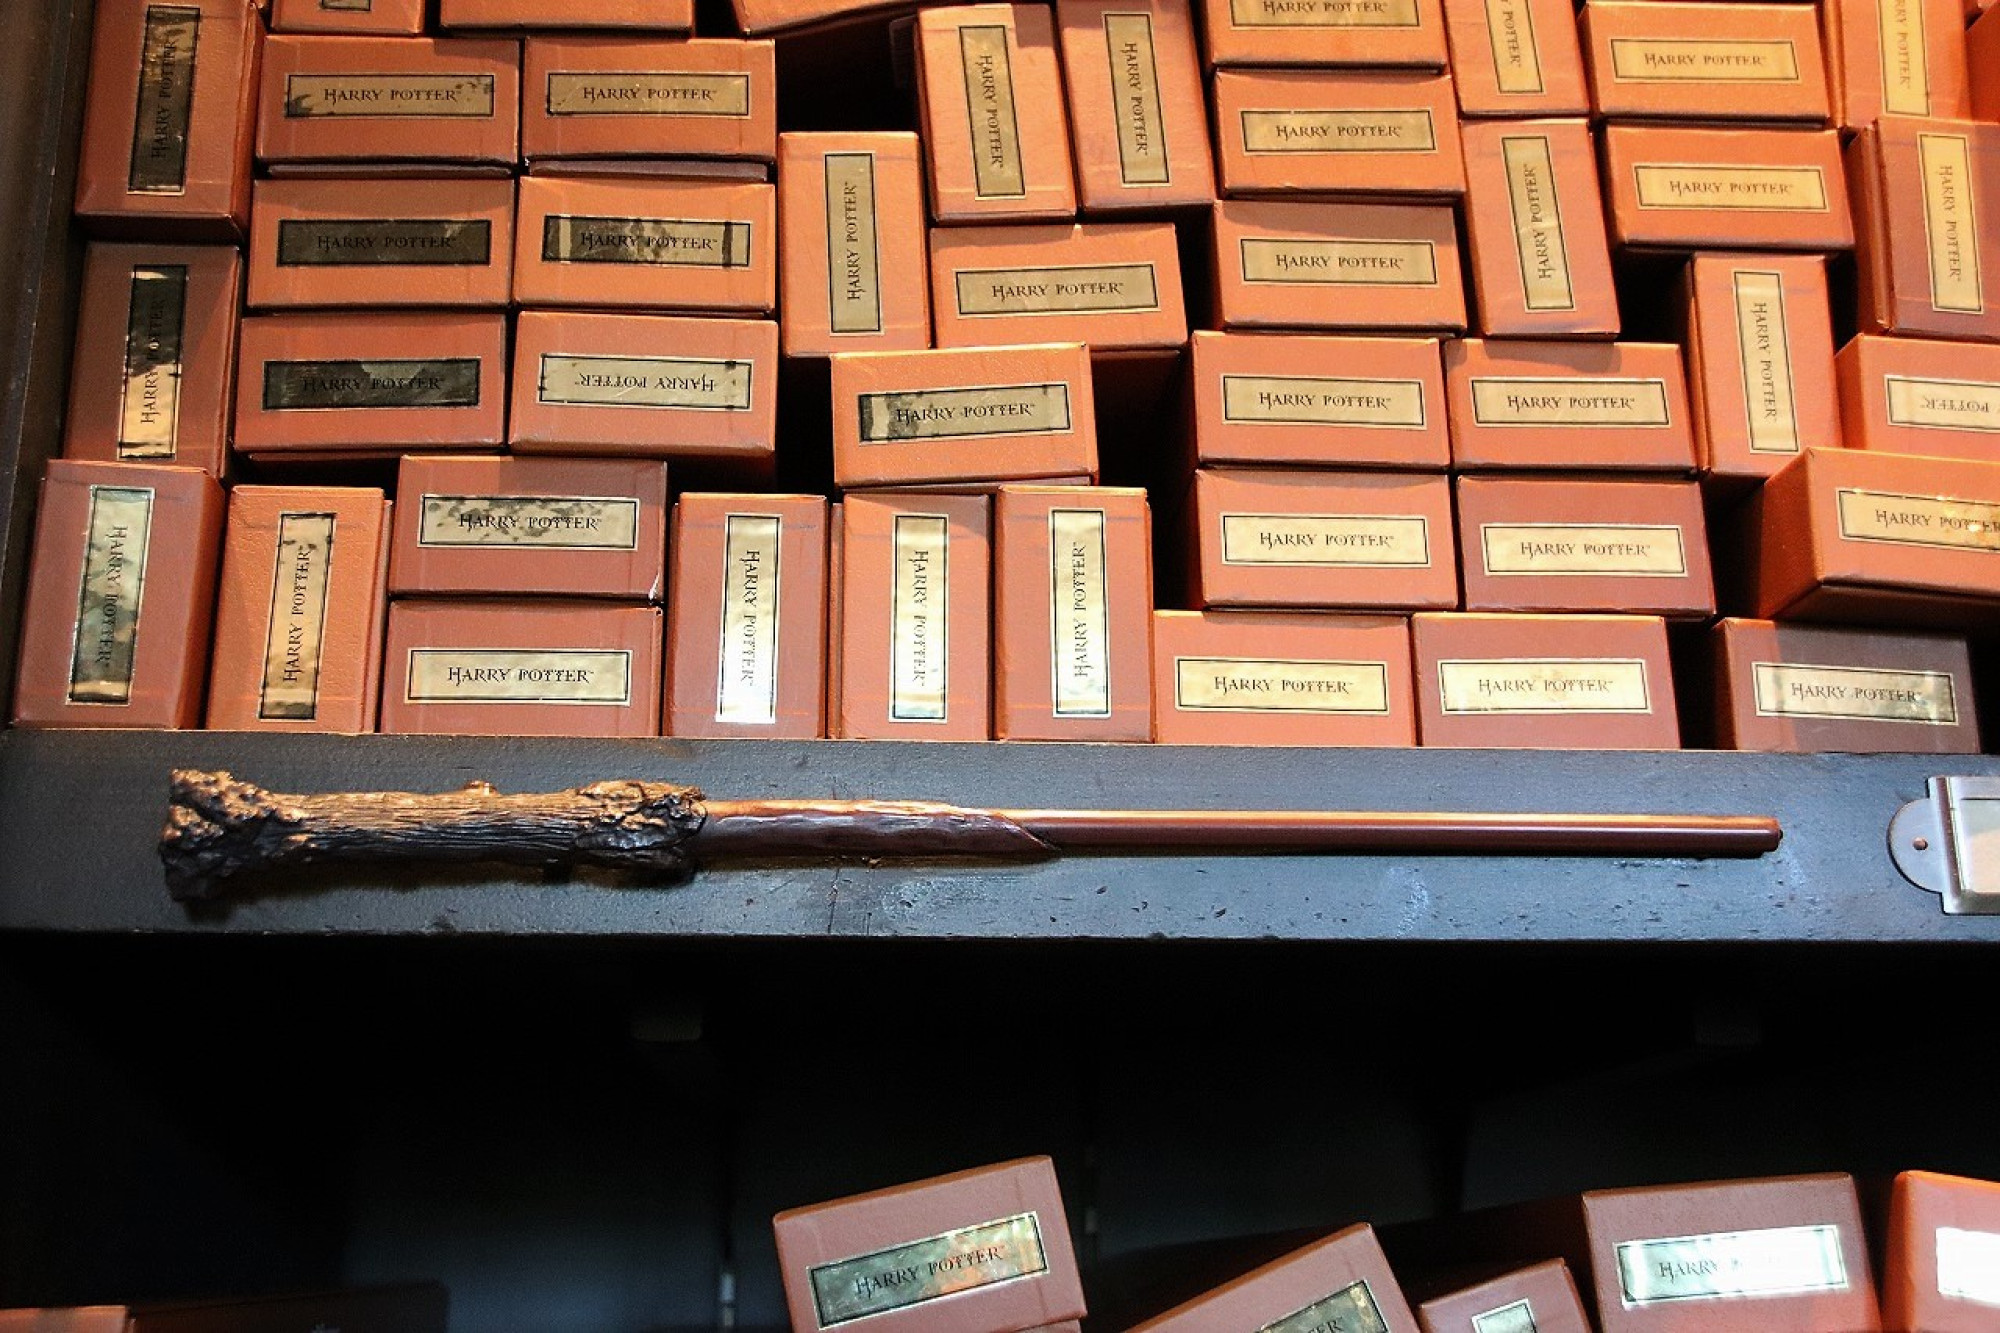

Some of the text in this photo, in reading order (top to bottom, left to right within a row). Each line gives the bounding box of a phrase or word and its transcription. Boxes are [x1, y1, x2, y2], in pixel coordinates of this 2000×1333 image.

[1263, 1, 1317, 16] HARRY
[1122, 42, 1142, 94] HARRY
[1644, 52, 1697, 69] HARRY
[975, 55, 997, 103] HARRY
[323, 88, 382, 106] HARRY
[583, 87, 641, 104] HARRY
[152, 104, 168, 160] HARRY
[1276, 124, 1331, 142] HARRY
[1669, 180, 1723, 197] HARRY
[1938, 165, 1958, 213] HARRY
[317, 234, 378, 253] HARRY
[580, 233, 640, 250] HARRY
[1275, 254, 1331, 271] HARRY
[1534, 230, 1553, 280] HARRY
[847, 247, 865, 301] HARRY
[992, 284, 1049, 301] HARRY
[1751, 302, 1771, 352] HARRY
[301, 377, 362, 392] HARRY
[655, 375, 718, 392] HARRY
[141, 369, 158, 424] HARRY
[1259, 392, 1315, 410] HARRY
[1507, 394, 1564, 412] HARRY
[896, 406, 957, 425] HARRY
[459, 513, 519, 530] HARRY
[1876, 509, 1932, 528] HARRY
[1259, 532, 1317, 549] HARRY
[105, 526, 128, 587] HARRY
[1520, 542, 1576, 560] HARRY
[739, 550, 760, 607] HARRY
[908, 550, 928, 607] HARRY
[283, 623, 305, 682] HARRY
[1075, 618, 1093, 677] HARRY
[448, 667, 511, 686] HARRY
[1214, 676, 1274, 696] HARRY
[1478, 678, 1537, 697] HARRY
[1790, 682, 1848, 703] HARRY
[854, 1265, 921, 1300] HARRY
